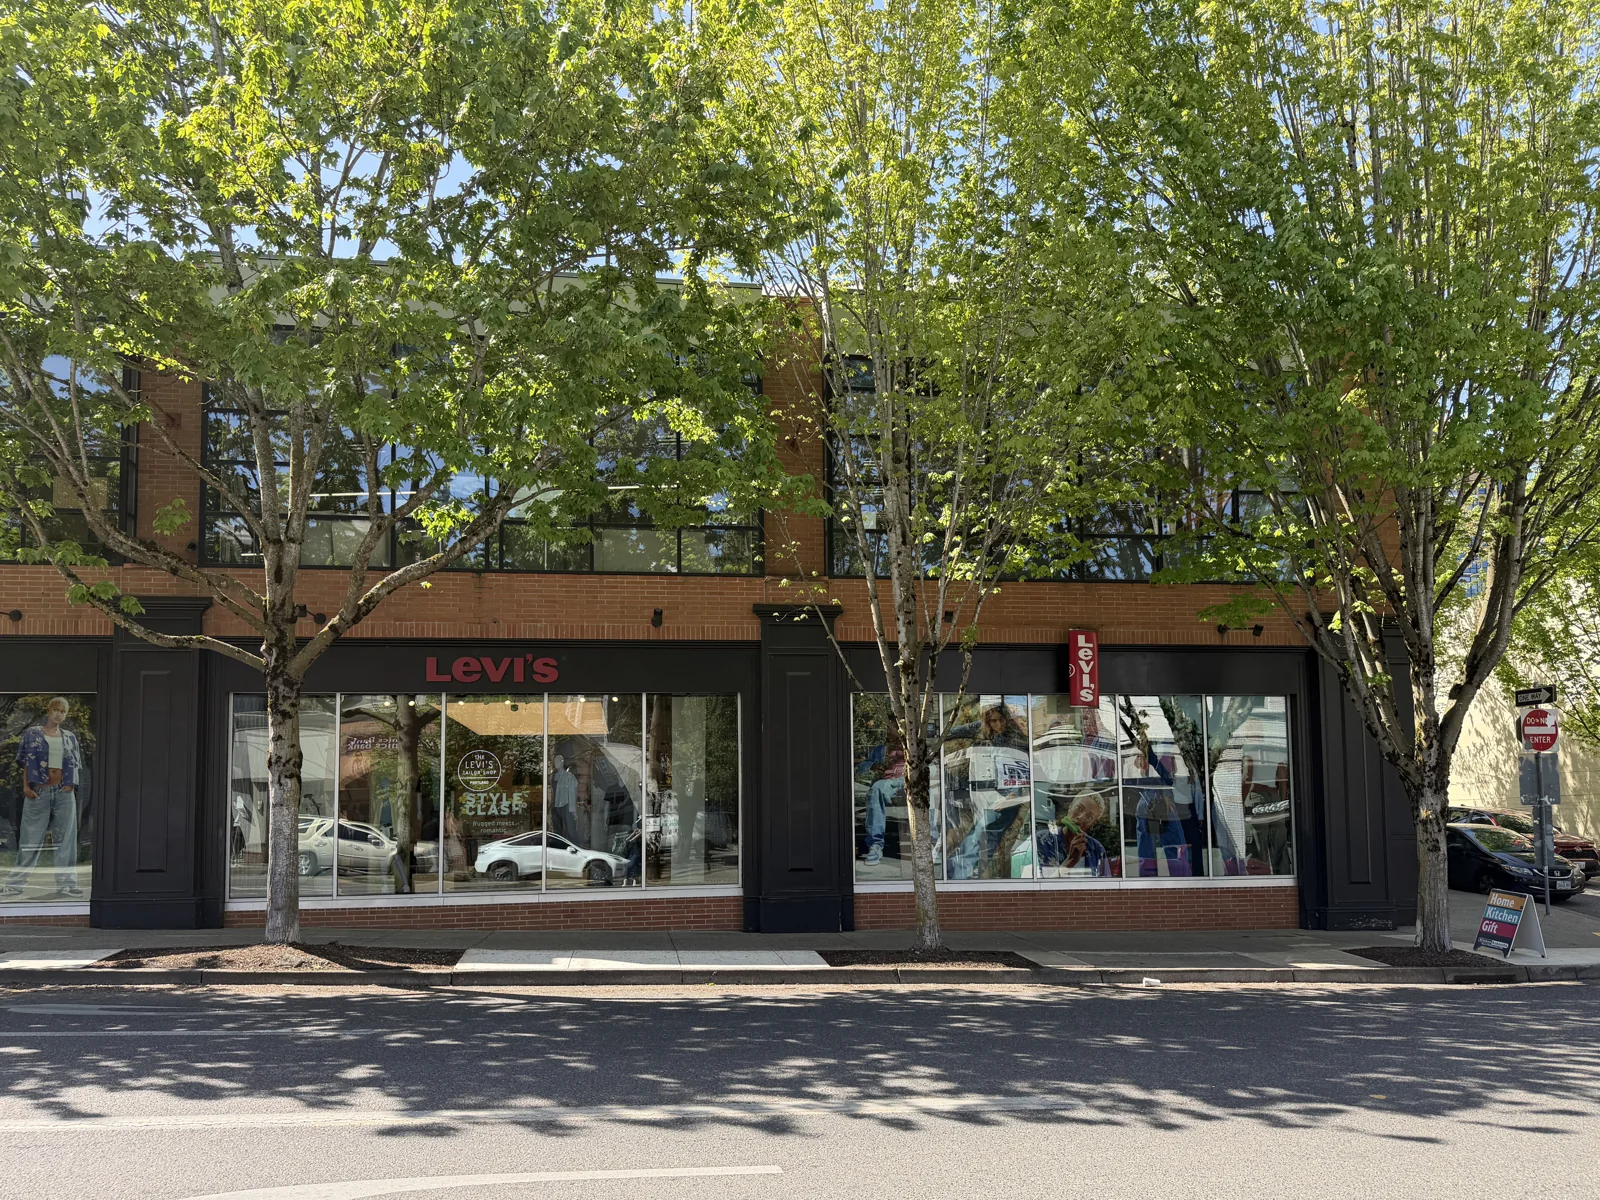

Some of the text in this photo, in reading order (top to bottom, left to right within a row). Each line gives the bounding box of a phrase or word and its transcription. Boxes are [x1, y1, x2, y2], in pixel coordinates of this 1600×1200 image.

[425, 653, 559, 683] Levi's
[1077, 634, 1095, 702] Levi's
[1518, 694, 1530, 702] ONE
[1526, 717, 1535, 725] DO
[465, 760, 494, 769] LEVI'S
[466, 793, 523, 805] STYLE
[465, 803, 523, 816] CLASH
[1490, 893, 1515, 908] Home
[1486, 906, 1519, 923] Kitchen
[1482, 920, 1498, 934] Gift
